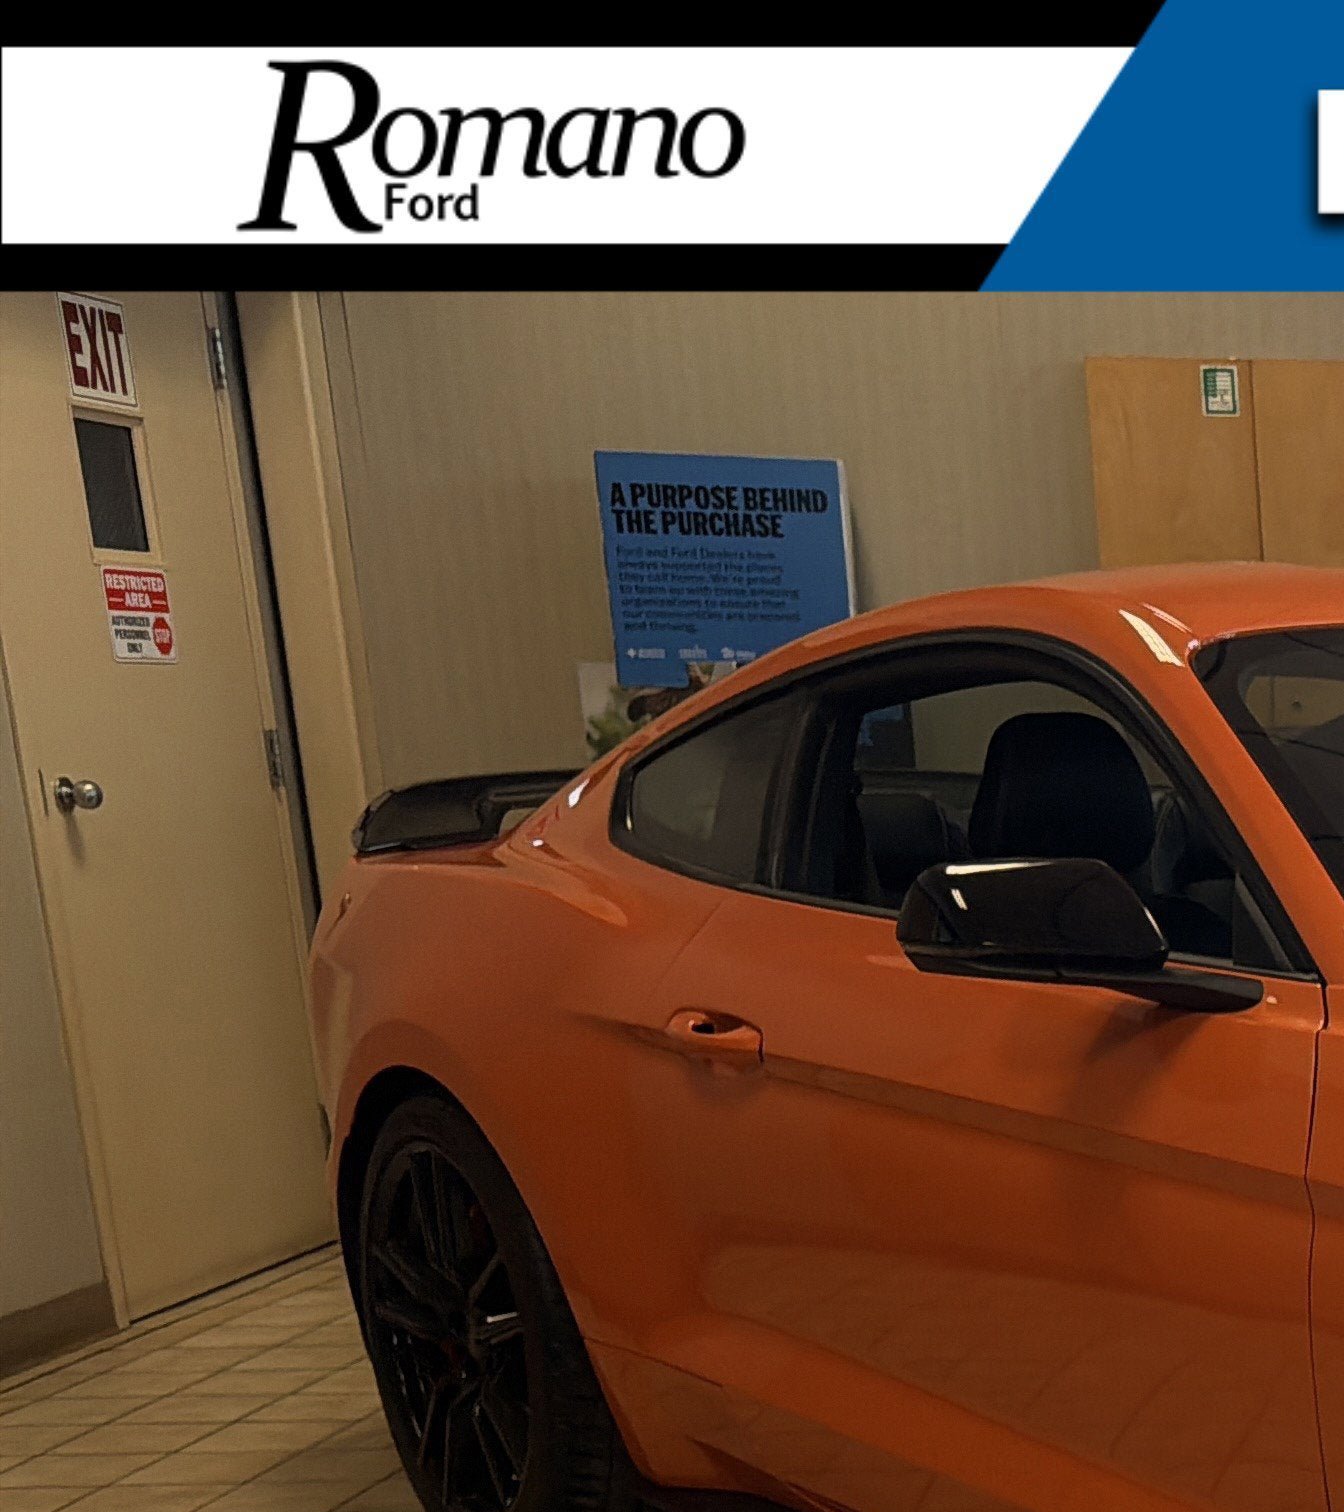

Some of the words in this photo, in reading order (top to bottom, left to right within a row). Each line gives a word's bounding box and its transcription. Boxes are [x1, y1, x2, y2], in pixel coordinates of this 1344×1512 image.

[61, 300, 128, 396] EXIT
[610, 482, 626, 507] A
[629, 483, 738, 511] PURPOSE
[742, 487, 829, 514] BEHIND
[611, 509, 658, 535] THE
[661, 511, 785, 538] PURCHASE
[105, 573, 164, 593] RESTRICTED
[124, 591, 152, 608] AREA
